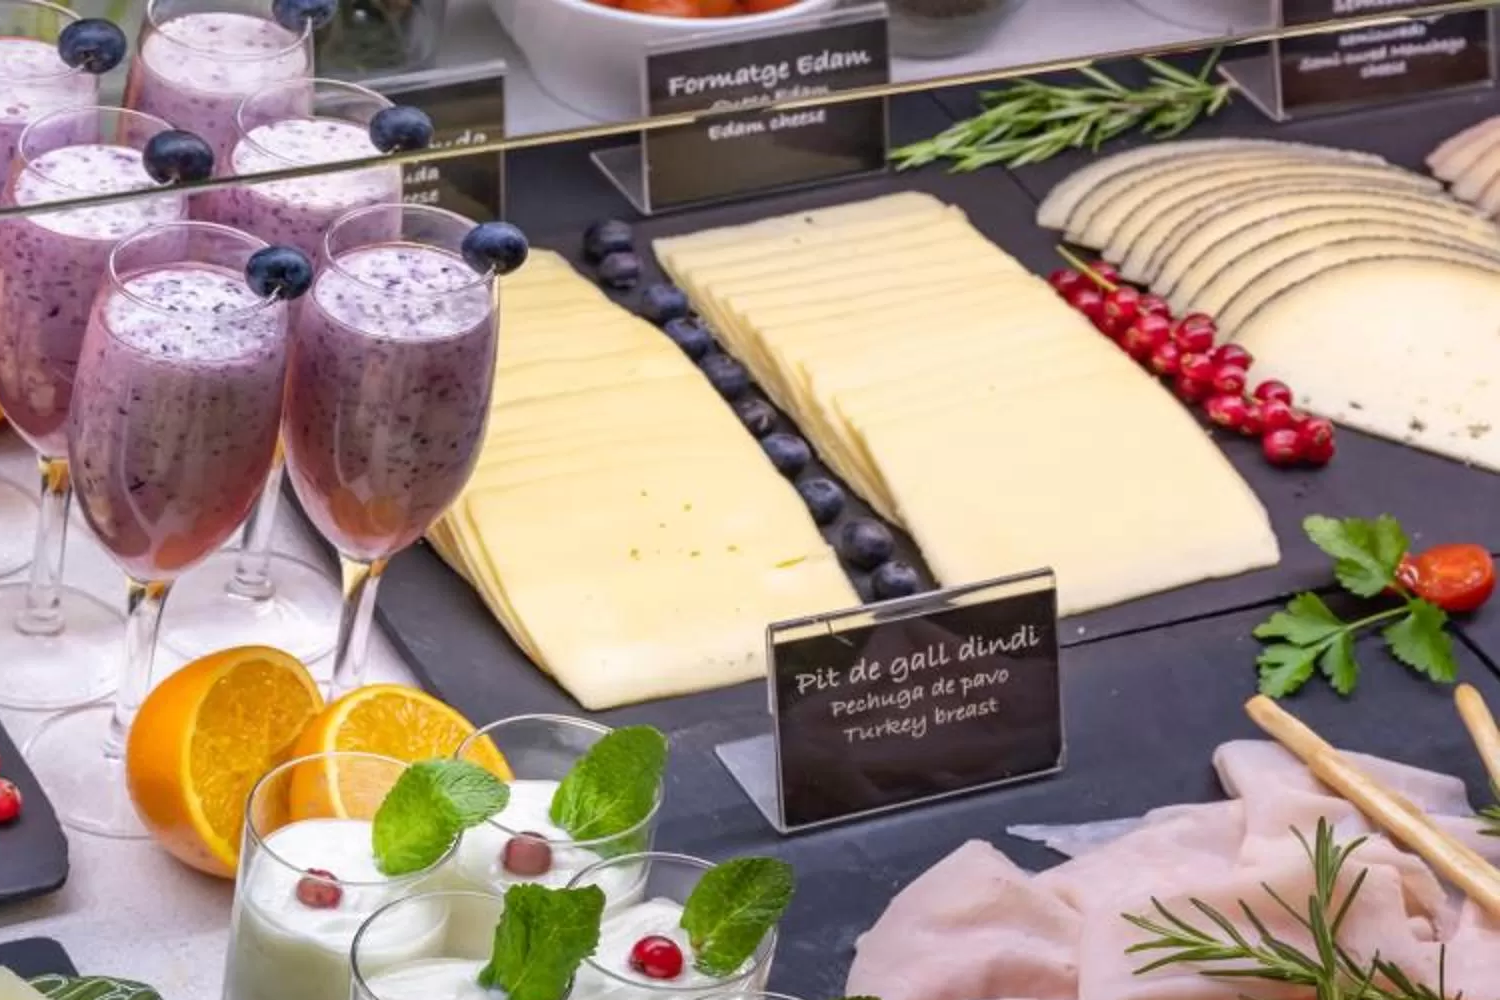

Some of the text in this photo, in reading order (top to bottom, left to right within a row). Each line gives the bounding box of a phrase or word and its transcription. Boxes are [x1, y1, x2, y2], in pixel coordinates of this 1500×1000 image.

[668, 50, 871, 96] Formatge Edam
[708, 109, 826, 140] Edam cheese
[795, 625, 1041, 694] Pit de gall dindi
[831, 668, 1009, 718] Pechuga de pavo
[844, 699, 998, 743] Turkey breast
